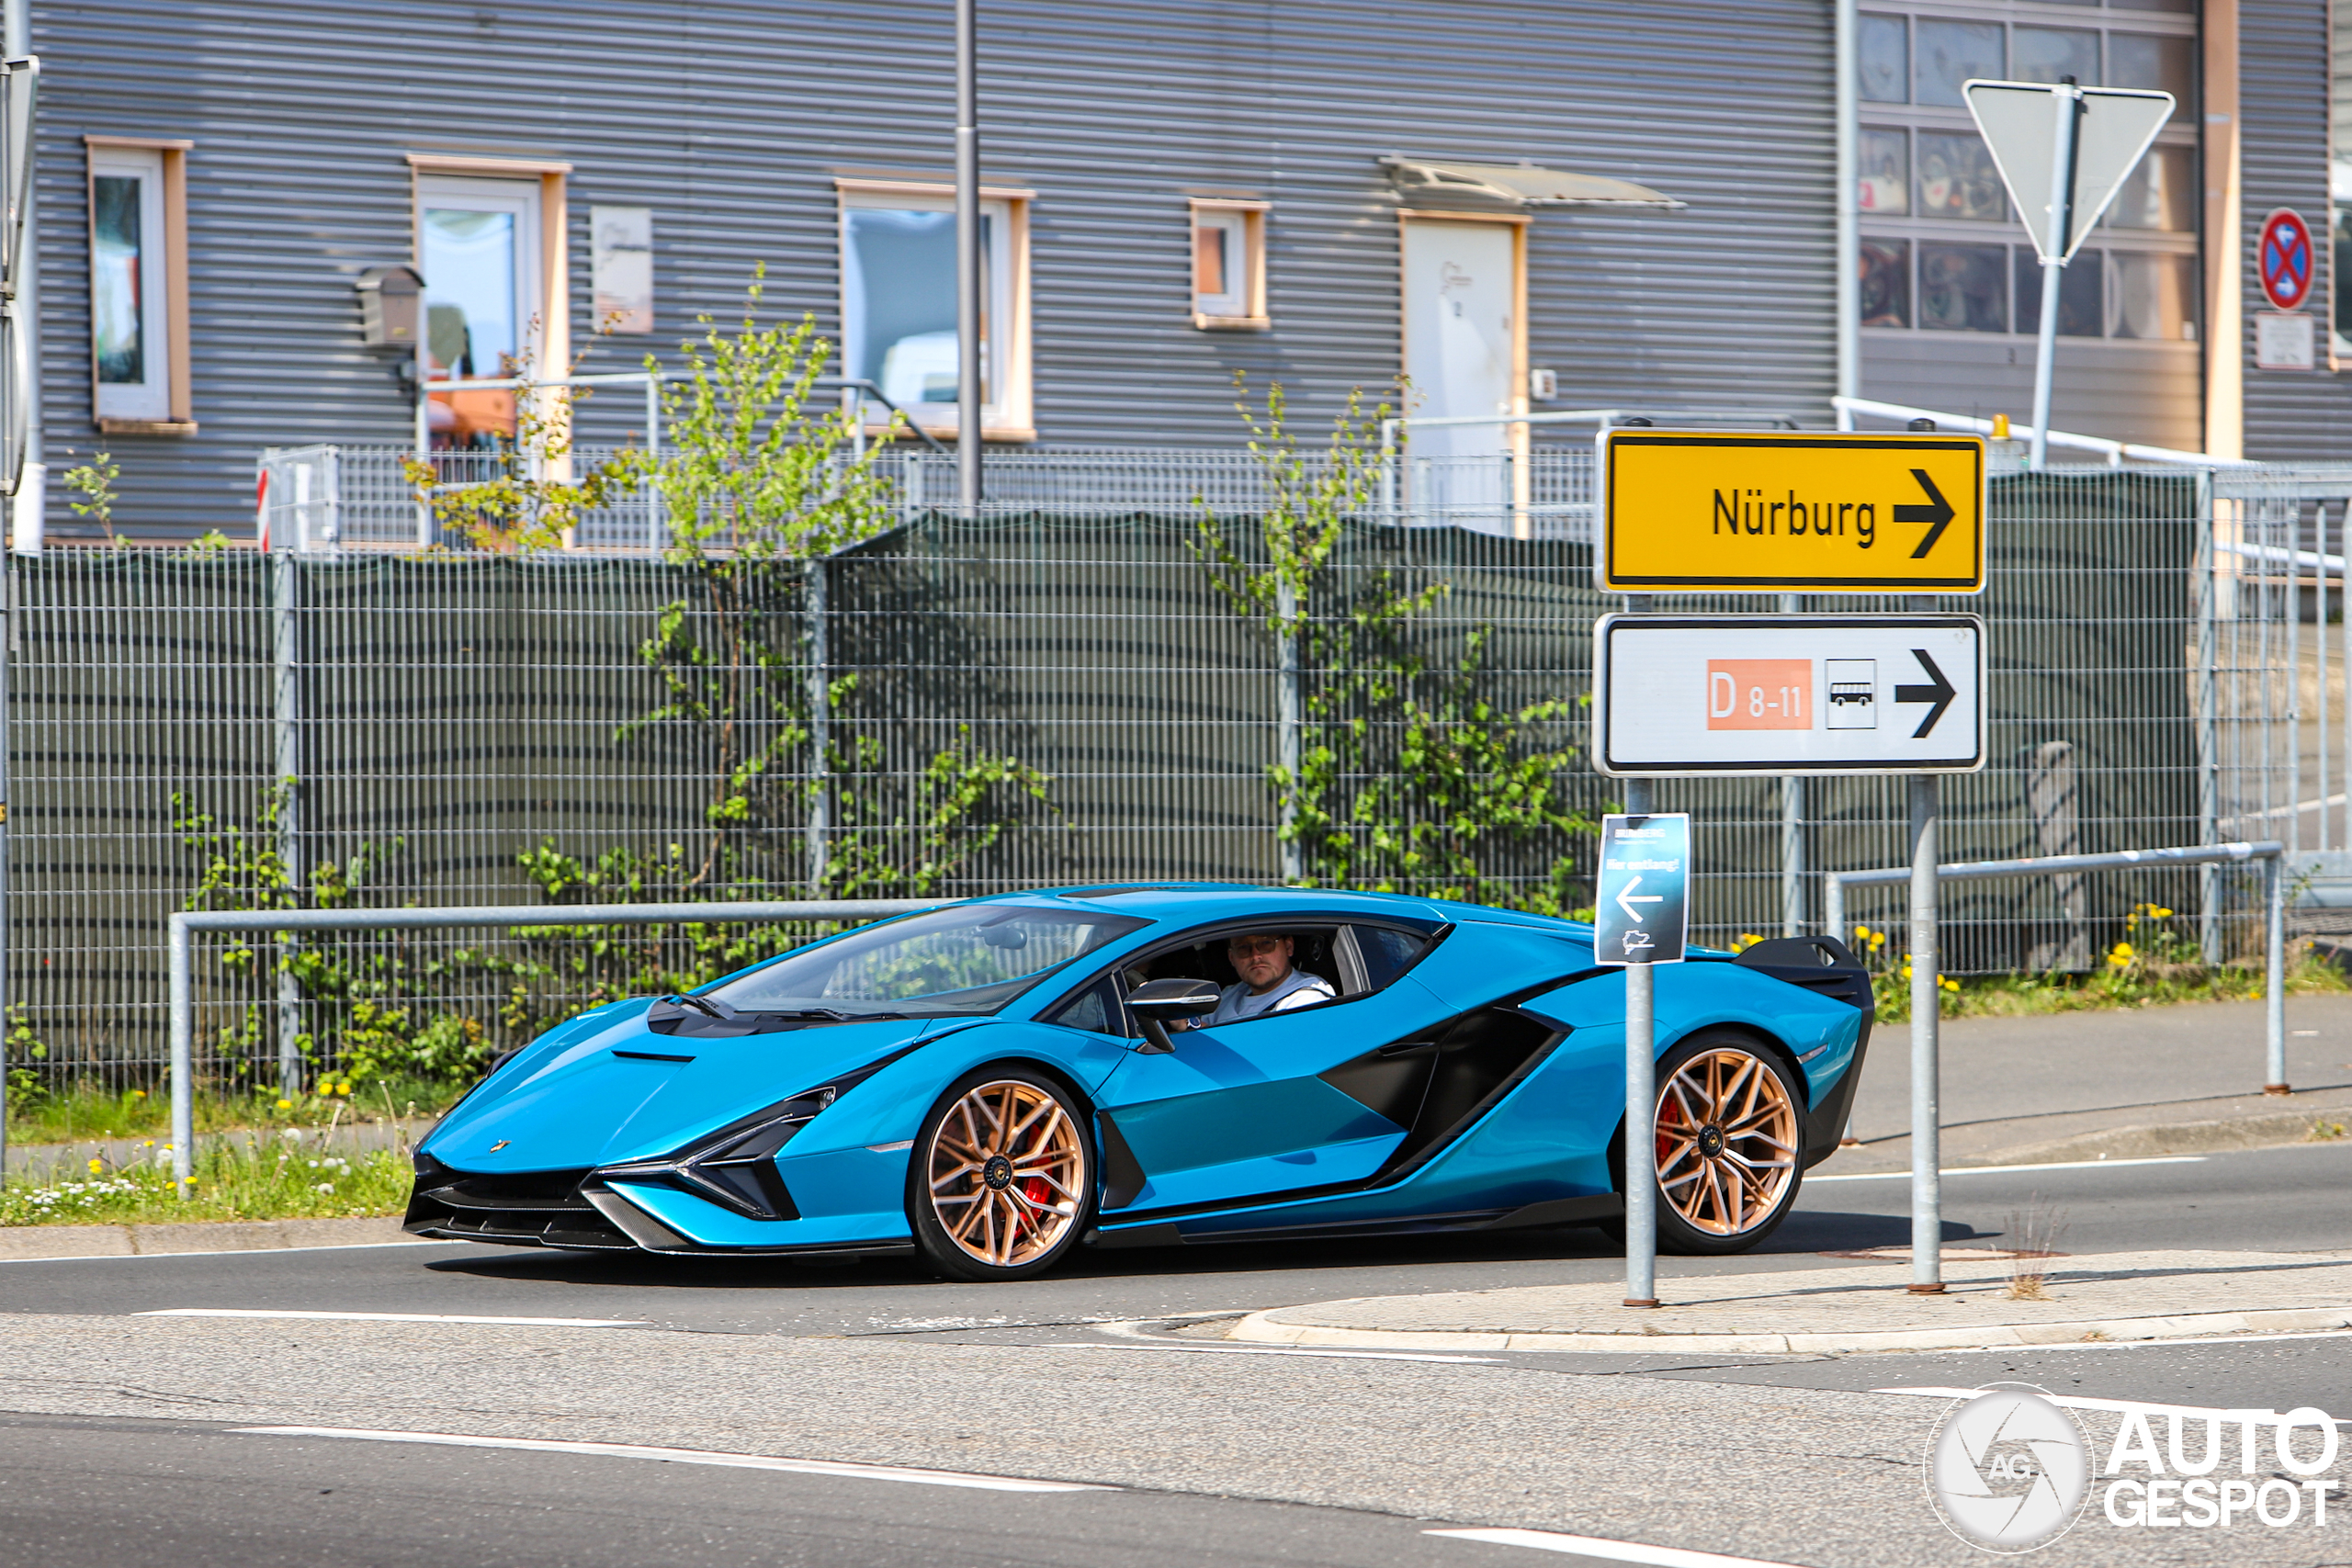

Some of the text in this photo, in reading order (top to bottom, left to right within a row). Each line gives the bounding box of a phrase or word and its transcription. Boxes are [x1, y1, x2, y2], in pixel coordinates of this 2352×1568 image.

[1713, 489, 1875, 549] Nürburg
[1710, 671, 1801, 718] D 8-11
